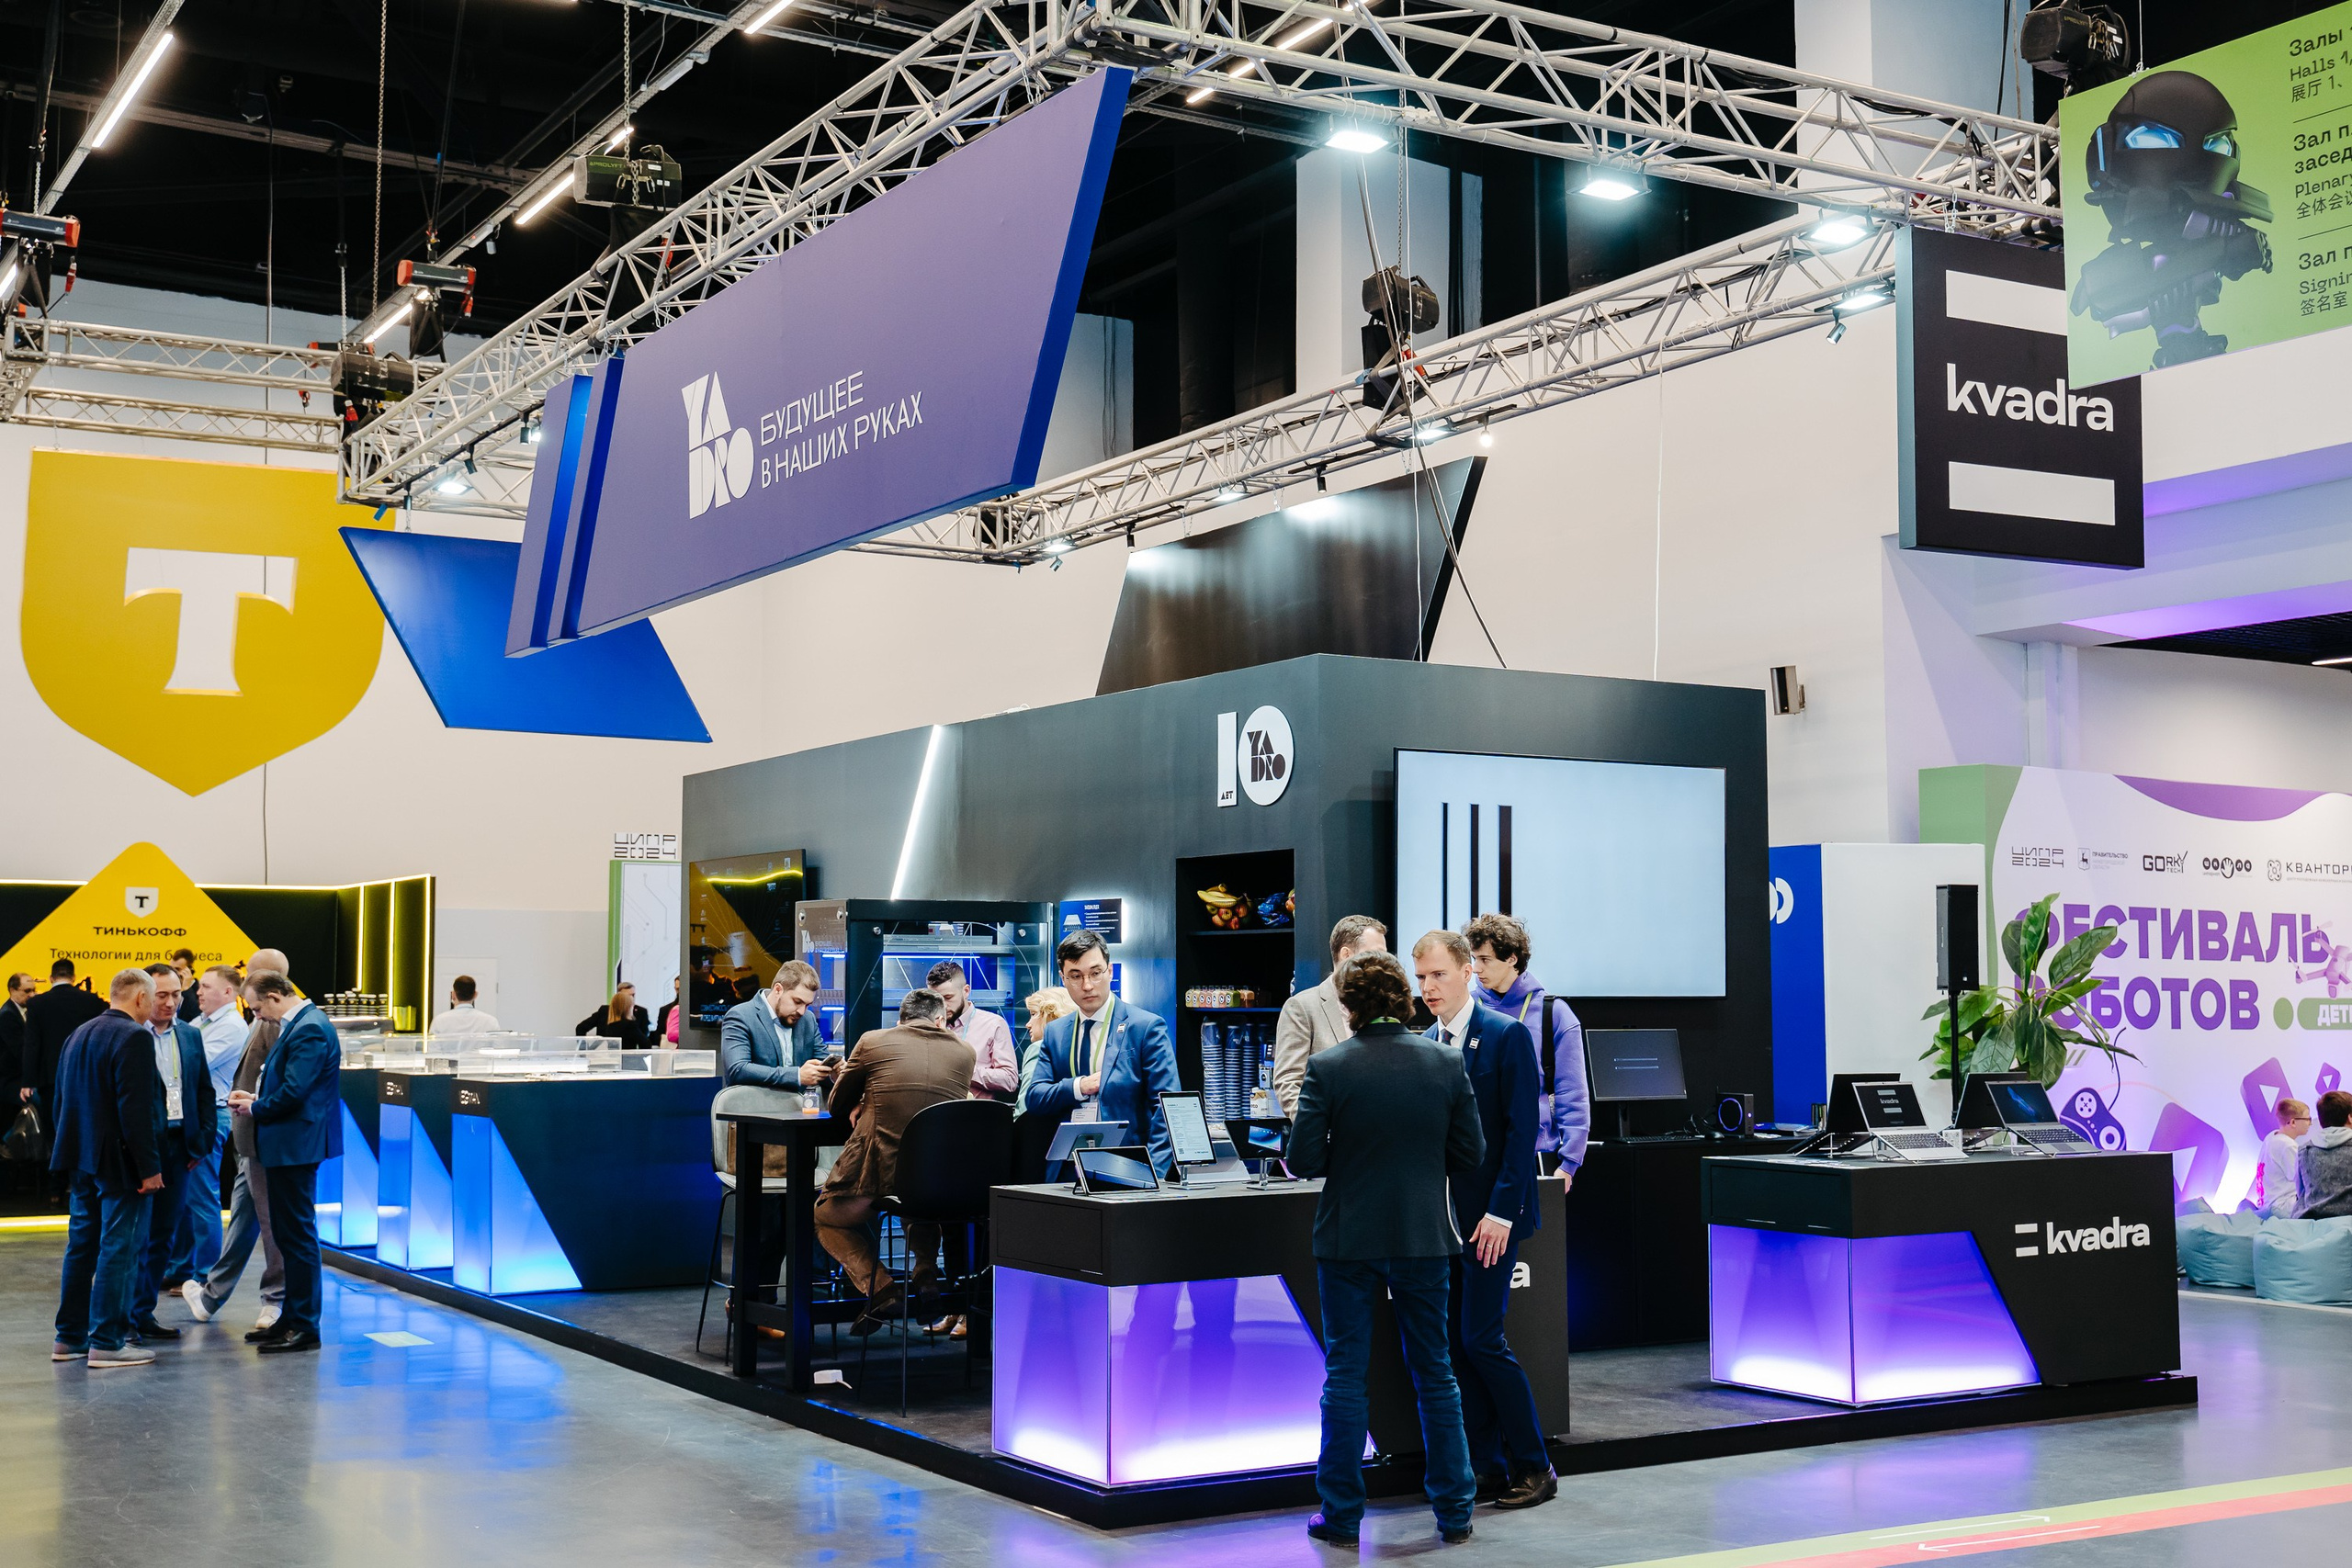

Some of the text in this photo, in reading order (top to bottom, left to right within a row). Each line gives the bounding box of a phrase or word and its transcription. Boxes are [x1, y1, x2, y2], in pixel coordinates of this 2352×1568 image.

[2290, 29, 2342, 56] Залы
[2290, 57, 2335, 82] Halls
[2293, 125, 2352, 152] Зал п
[2295, 175, 2352, 197] Plenar
[2299, 250, 2335, 270] Зал
[2301, 291, 2347, 317] 签名室
[761, 370, 864, 446] БУДУЩЕЕ
[1947, 363, 2114, 433] kvadra
[762, 390, 923, 489] В НАШИХ РУКАХ
[615, 833, 676, 845] ЦИПР
[615, 847, 676, 859] 2024
[2012, 846, 2064, 857] ЦИПР
[2012, 857, 2064, 867] 2024
[2143, 851, 2188, 873] GORKY
[2286, 863, 2352, 874] КВАНТОР
[93, 927, 187, 936] ТИНЬКОФФ
[50, 948, 222, 962] Технологии для беса
[2317, 1004, 2352, 1026] ДЕТ
[2046, 1216, 2150, 1255] kvadra
